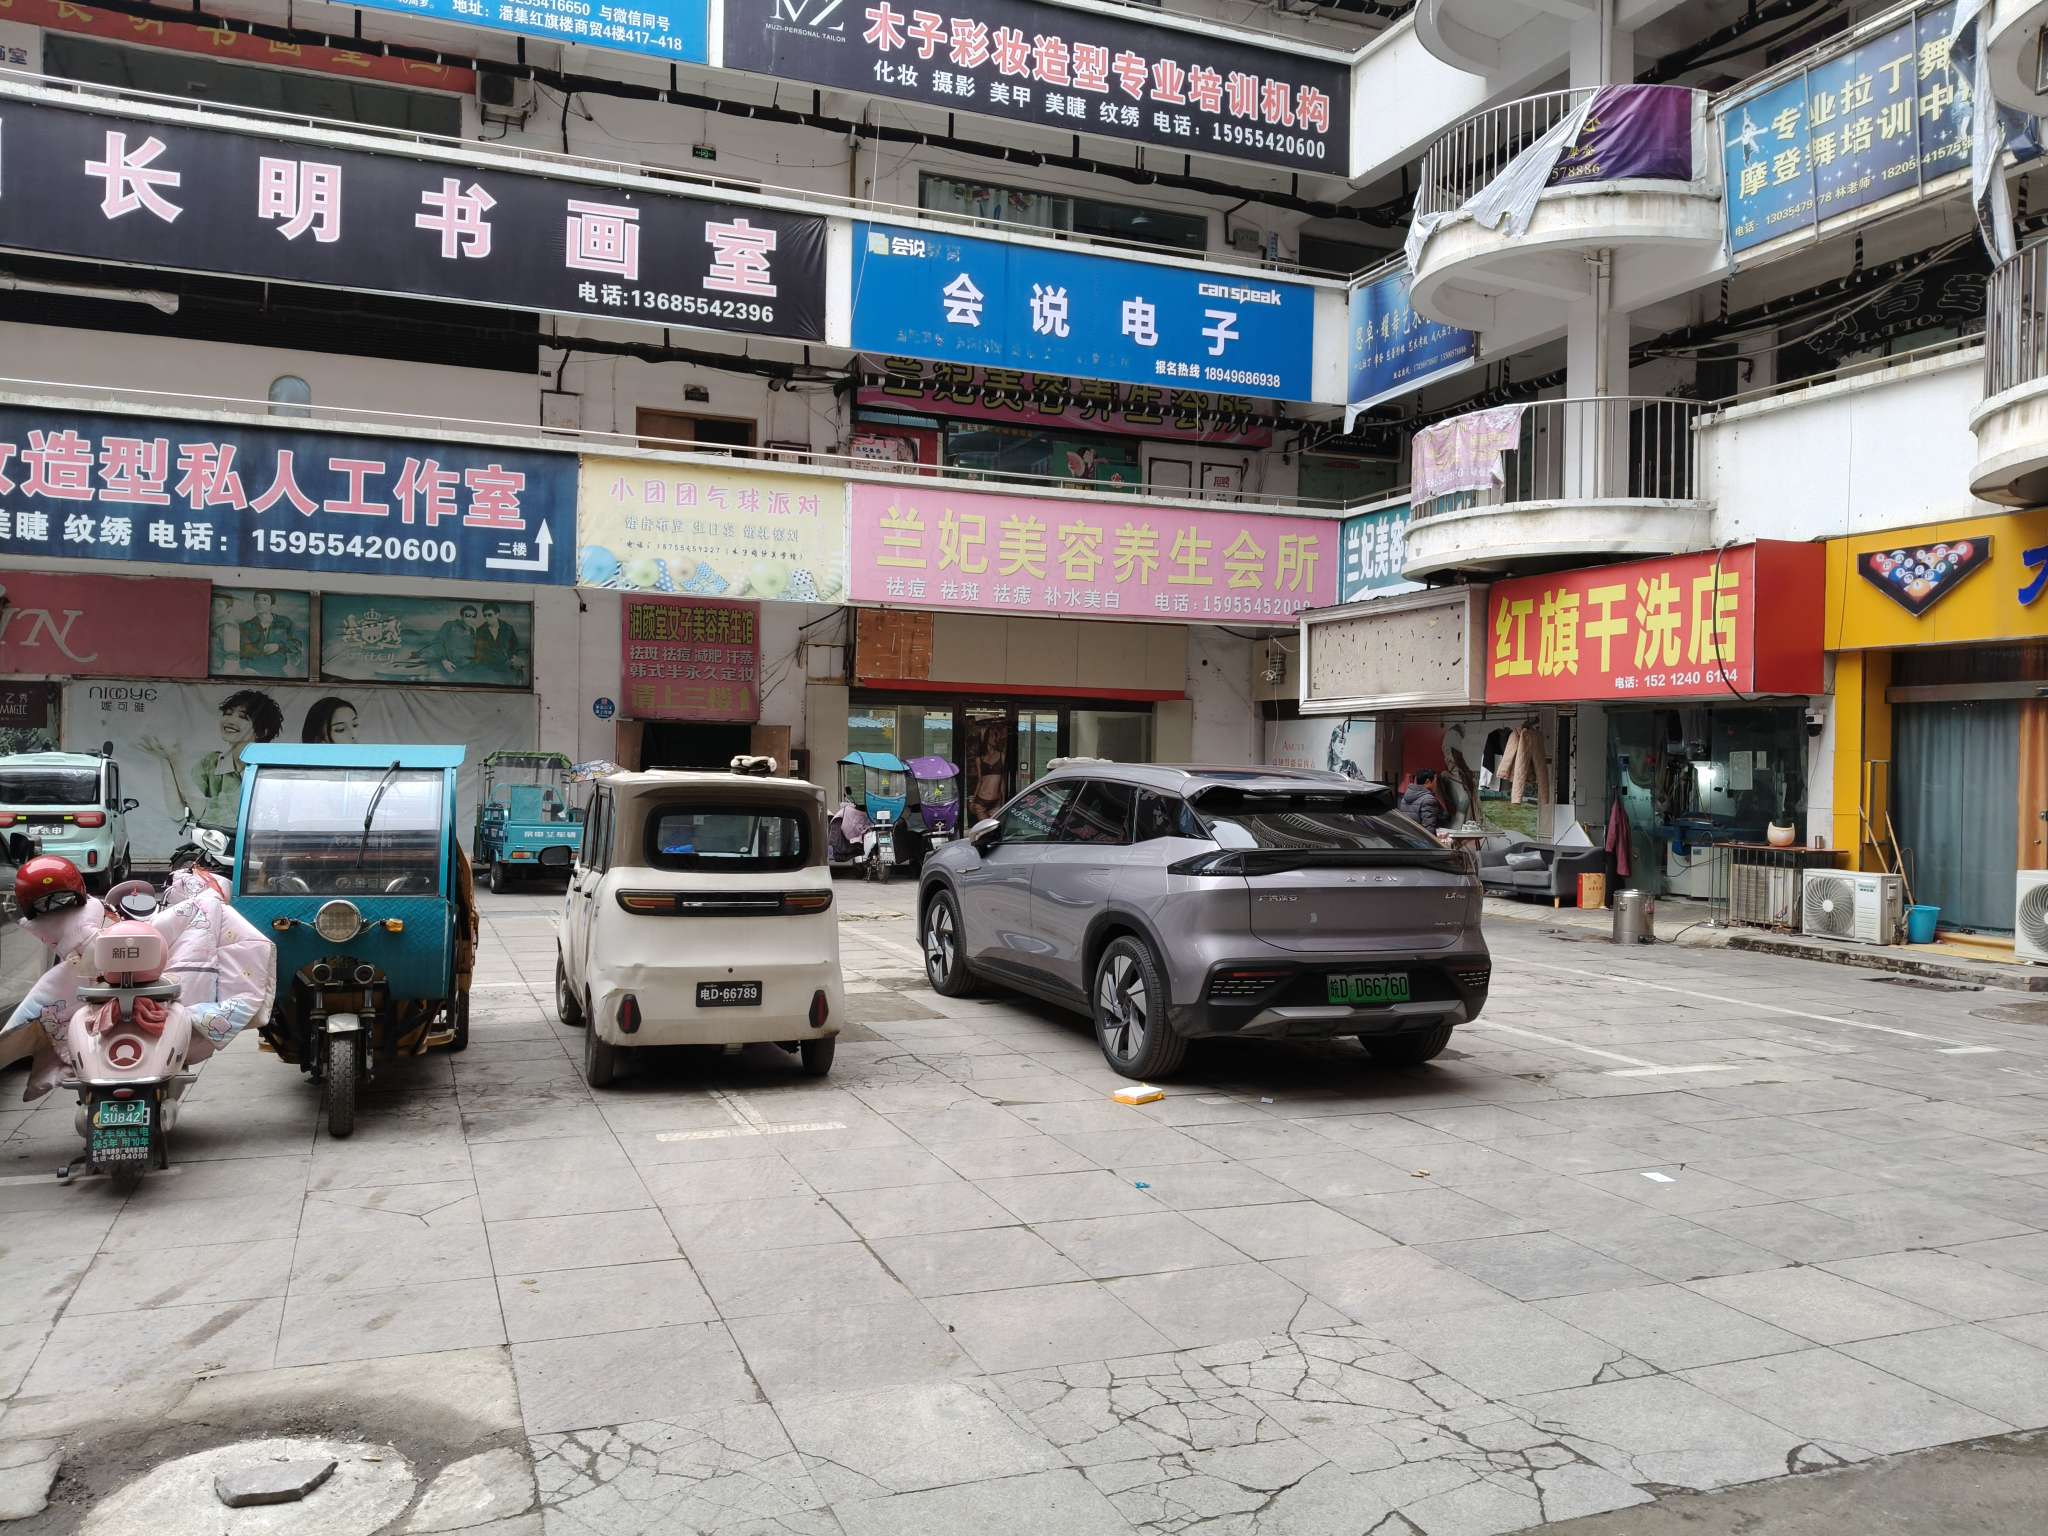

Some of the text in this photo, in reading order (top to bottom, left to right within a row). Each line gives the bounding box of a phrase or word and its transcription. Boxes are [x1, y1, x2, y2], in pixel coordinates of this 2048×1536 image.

[600, 6, 670, 32] 与微信同号
[863, 1, 1330, 134] 木子彩妆造型专业培训机构
[873, 59, 918, 87] 化妆
[932, 70, 975, 98] 摄影
[990, 81, 1031, 109] 美甲
[1045, 92, 1087, 120] 美睫
[1099, 101, 1140, 128] 纹绣
[84, 130, 777, 297] 长明书画室
[942, 272, 1240, 357] 会说电子
[1155, 359, 1281, 388] 报名热线 18949686938
[610, 477, 821, 517] 小团团气球派对
[63, 513, 133, 547] 纹绣
[497, 541, 528, 557] 二楼
[876, 504, 1319, 593] 兰妃美容养生会所
[886, 576, 927, 599] 祛痘
[940, 580, 980, 601] 祛斑
[1044, 586, 1120, 610] 补水美白
[1494, 563, 1740, 678] 红旗干洗店
[112, 947, 139, 959] 新日
